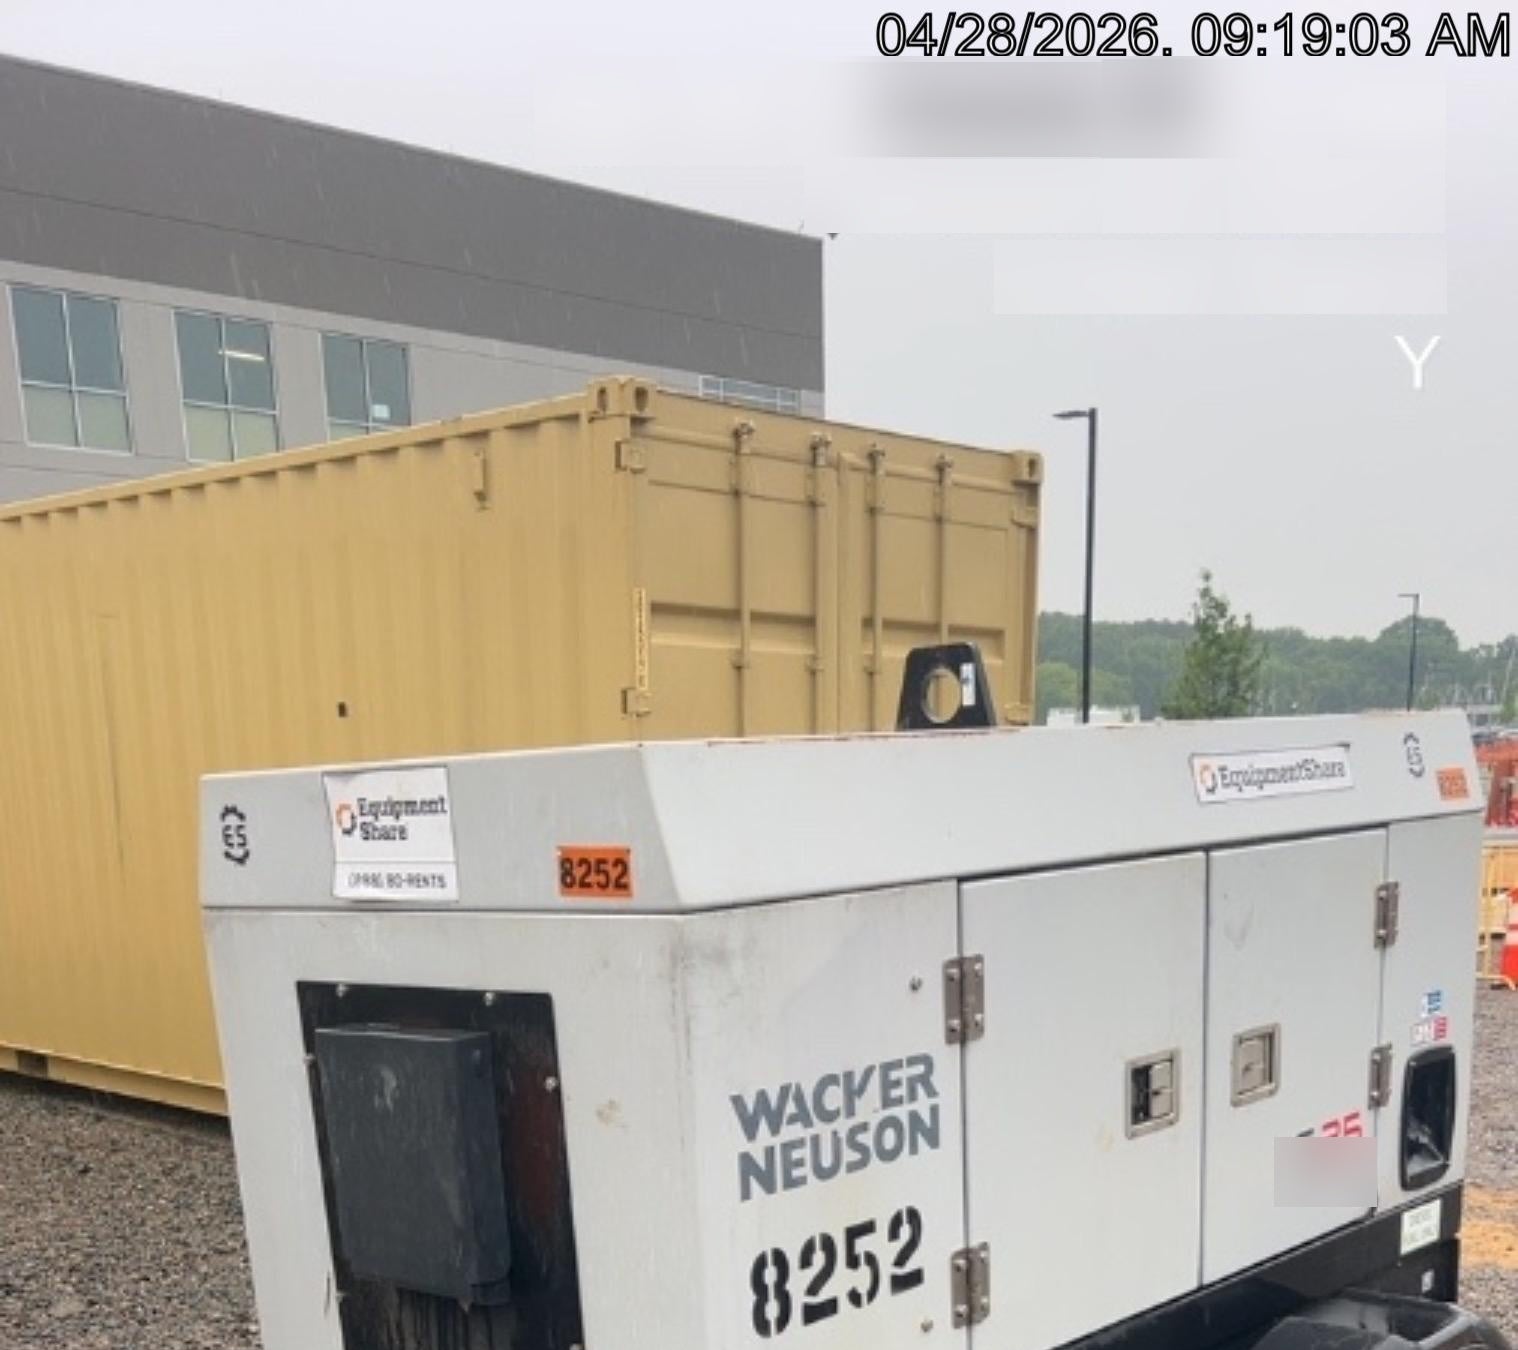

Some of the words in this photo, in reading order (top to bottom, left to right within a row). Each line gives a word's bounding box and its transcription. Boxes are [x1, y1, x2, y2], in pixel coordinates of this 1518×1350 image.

[357, 796, 448, 821] Equipment
[360, 822, 408, 841] Share
[560, 857, 629, 889] 8252
[729, 1053, 940, 1143] WACKER
[738, 1103, 940, 1202] NEUSON
[750, 1206, 925, 1338] 8252
